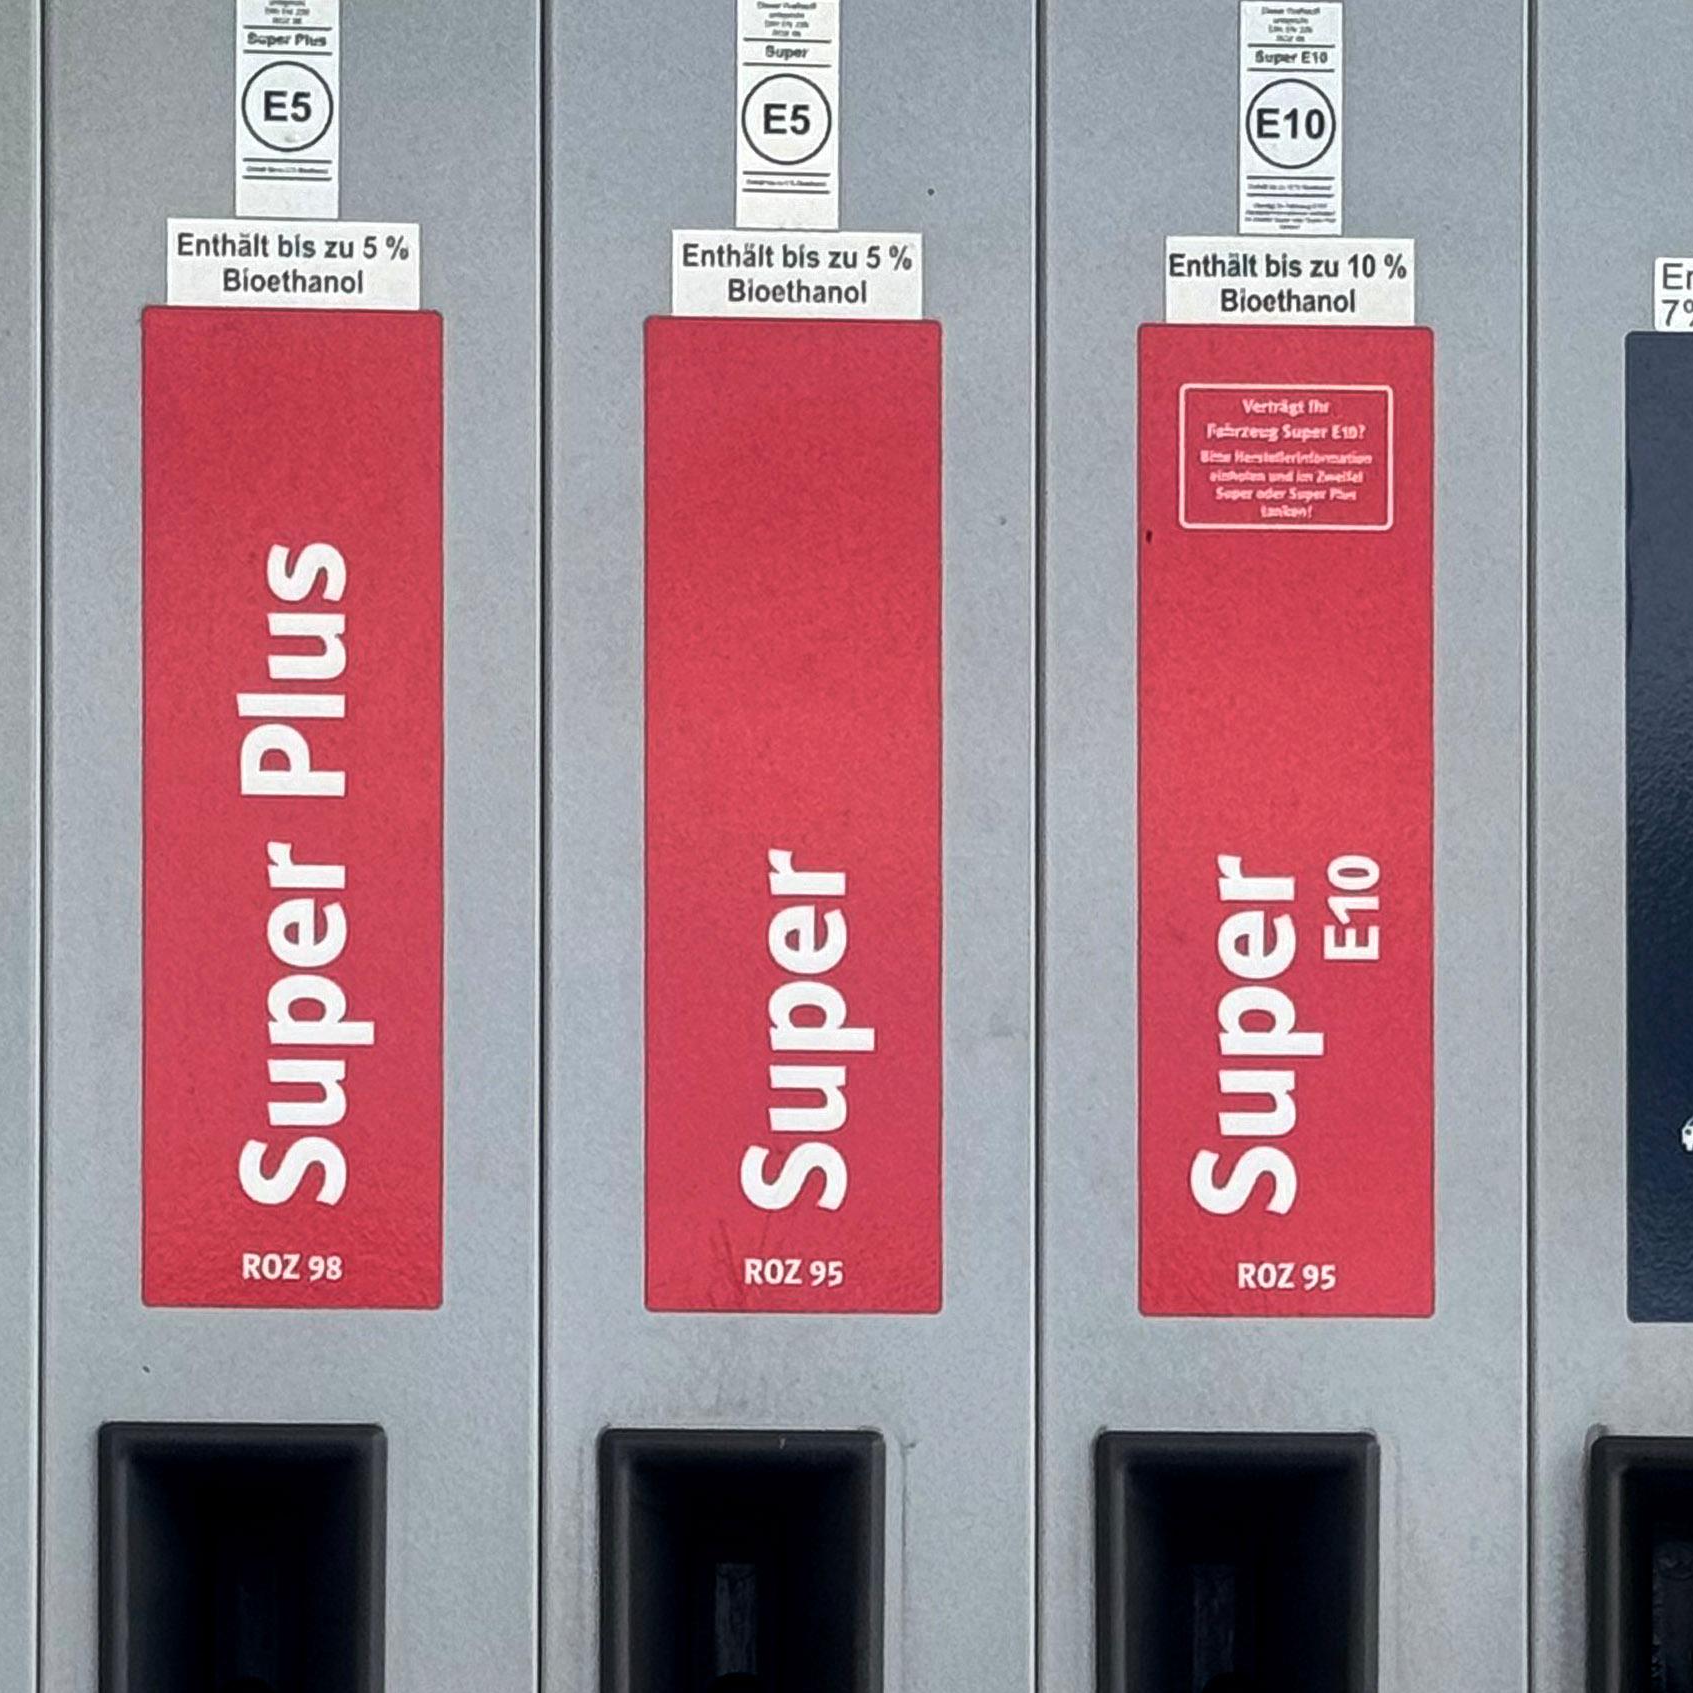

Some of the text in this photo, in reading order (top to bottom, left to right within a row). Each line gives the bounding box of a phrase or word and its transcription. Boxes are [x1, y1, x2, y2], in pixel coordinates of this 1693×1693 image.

[766, 45, 808, 60] Super
[1255, 50, 1328, 65] Super E10
[264, 90, 312, 122] E5
[763, 103, 811, 135] E5
[1256, 108, 1325, 139] E10
[177, 232, 410, 261] Enthält bis zu 5 %
[682, 243, 913, 271] Enthält bis zu 5 %
[1168, 252, 1408, 280] Enthält bis zu 10 %
[222, 268, 364, 294] Bioethanol
[728, 278, 868, 304] Bioethanol
[1220, 288, 1357, 313] Bioethanol
[1242, 398, 1330, 418] Verträgt Ihr
[1207, 422, 1366, 443] Fahrzeug Super E10?
[1215, 486, 1253, 501] Super
[1255, 487, 1287, 500] oder
[1288, 487, 1327, 503] Super
[236, 541, 375, 1207] Super Plus
[1323, 854, 1381, 961] E10
[740, 848, 876, 1212] Super
[1190, 854, 1325, 1215] Super
[242, 1252, 343, 1282] ROZ 98
[744, 1258, 845, 1287] ROZ 95
[1237, 1262, 1337, 1291] ROZ 95
